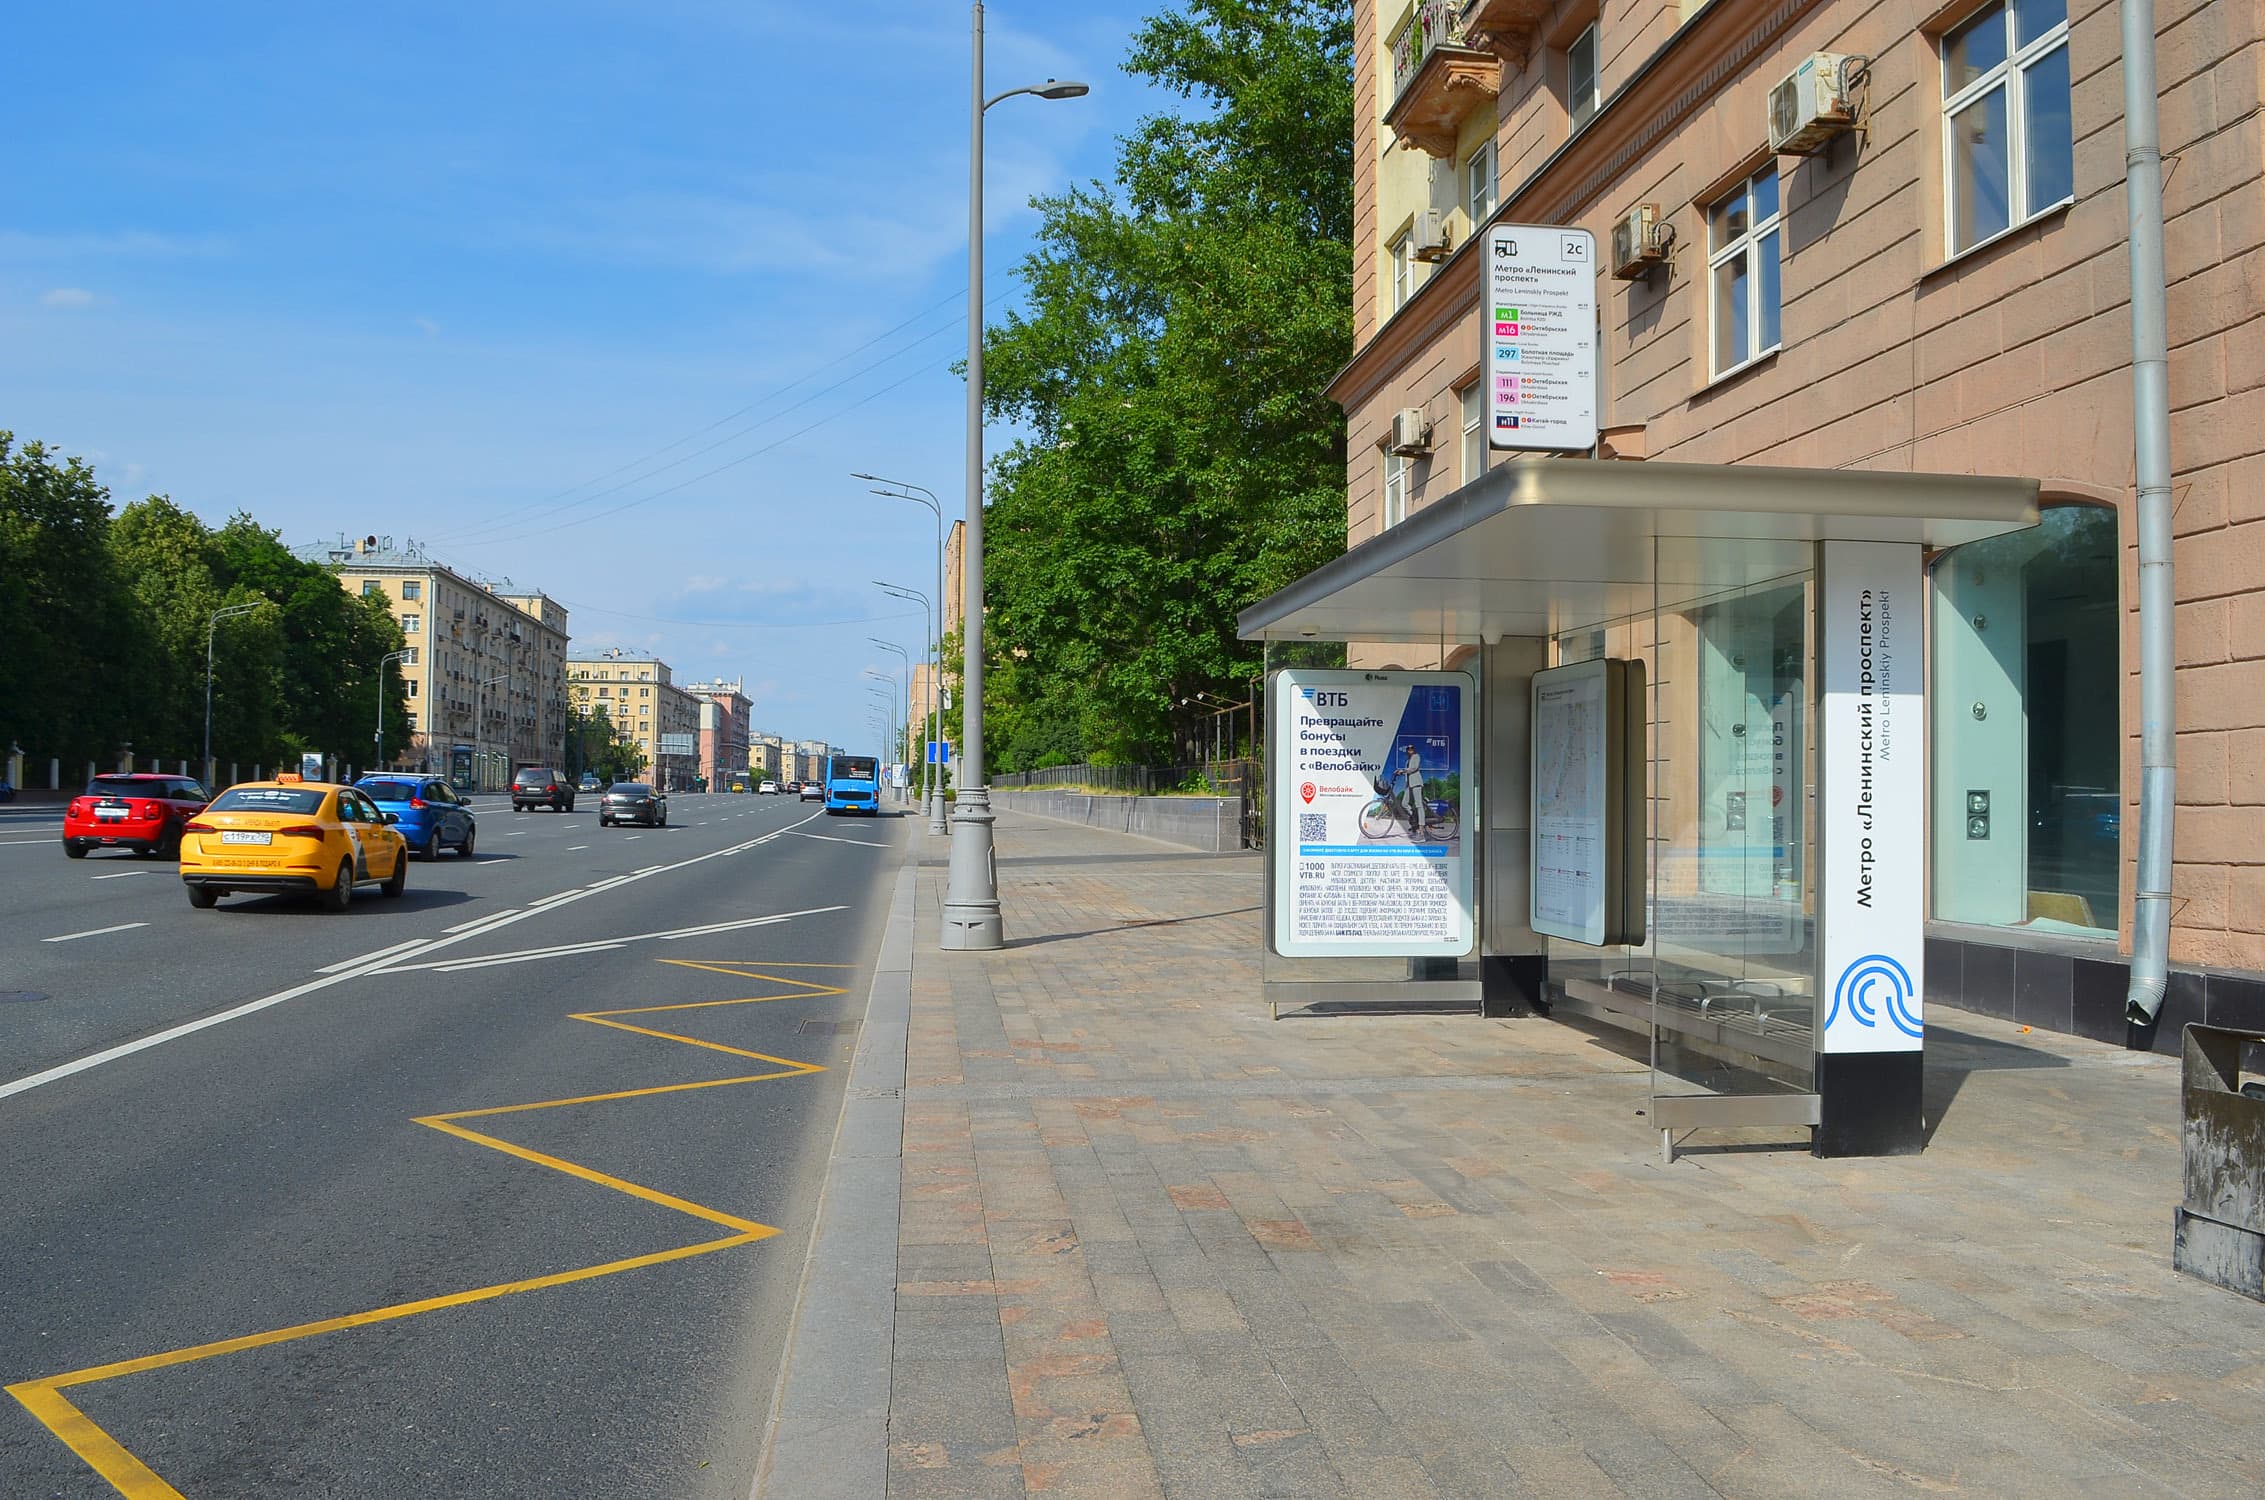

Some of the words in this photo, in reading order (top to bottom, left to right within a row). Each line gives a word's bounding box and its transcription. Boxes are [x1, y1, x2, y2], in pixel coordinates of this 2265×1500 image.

[1495, 264, 1524, 274] Метро
[1525, 265, 1577, 276] «Ленинский
[1494, 274, 1539, 283] проспект»
[1543, 288, 1569, 296] Prospekt
[1498, 325, 1516, 334] м16
[1498, 349, 1516, 358] 297
[1502, 378, 1513, 387] 111
[1499, 393, 1515, 402] 196
[1532, 417, 1567, 425] Китай-город
[1879, 590, 1892, 649] Prospekt
[1859, 588, 1876, 696] проспект»
[1879, 652, 1892, 714] Leninskiy
[1317, 692, 1348, 707] ВТБ
[1300, 715, 1384, 728] Превращайте
[1300, 730, 1346, 743] бонусы
[1879, 719, 1891, 761] Metro
[1432, 739, 1446, 747] ВТБ
[1310, 748, 1362, 757] поездки
[1309, 761, 1381, 771] «Велобайк»
[1856, 702, 1874, 831] «Ленинский
[1319, 785, 1353, 793] Велобайк
[1306, 862, 1325, 870] 1000
[1857, 838, 1876, 908] Метро
